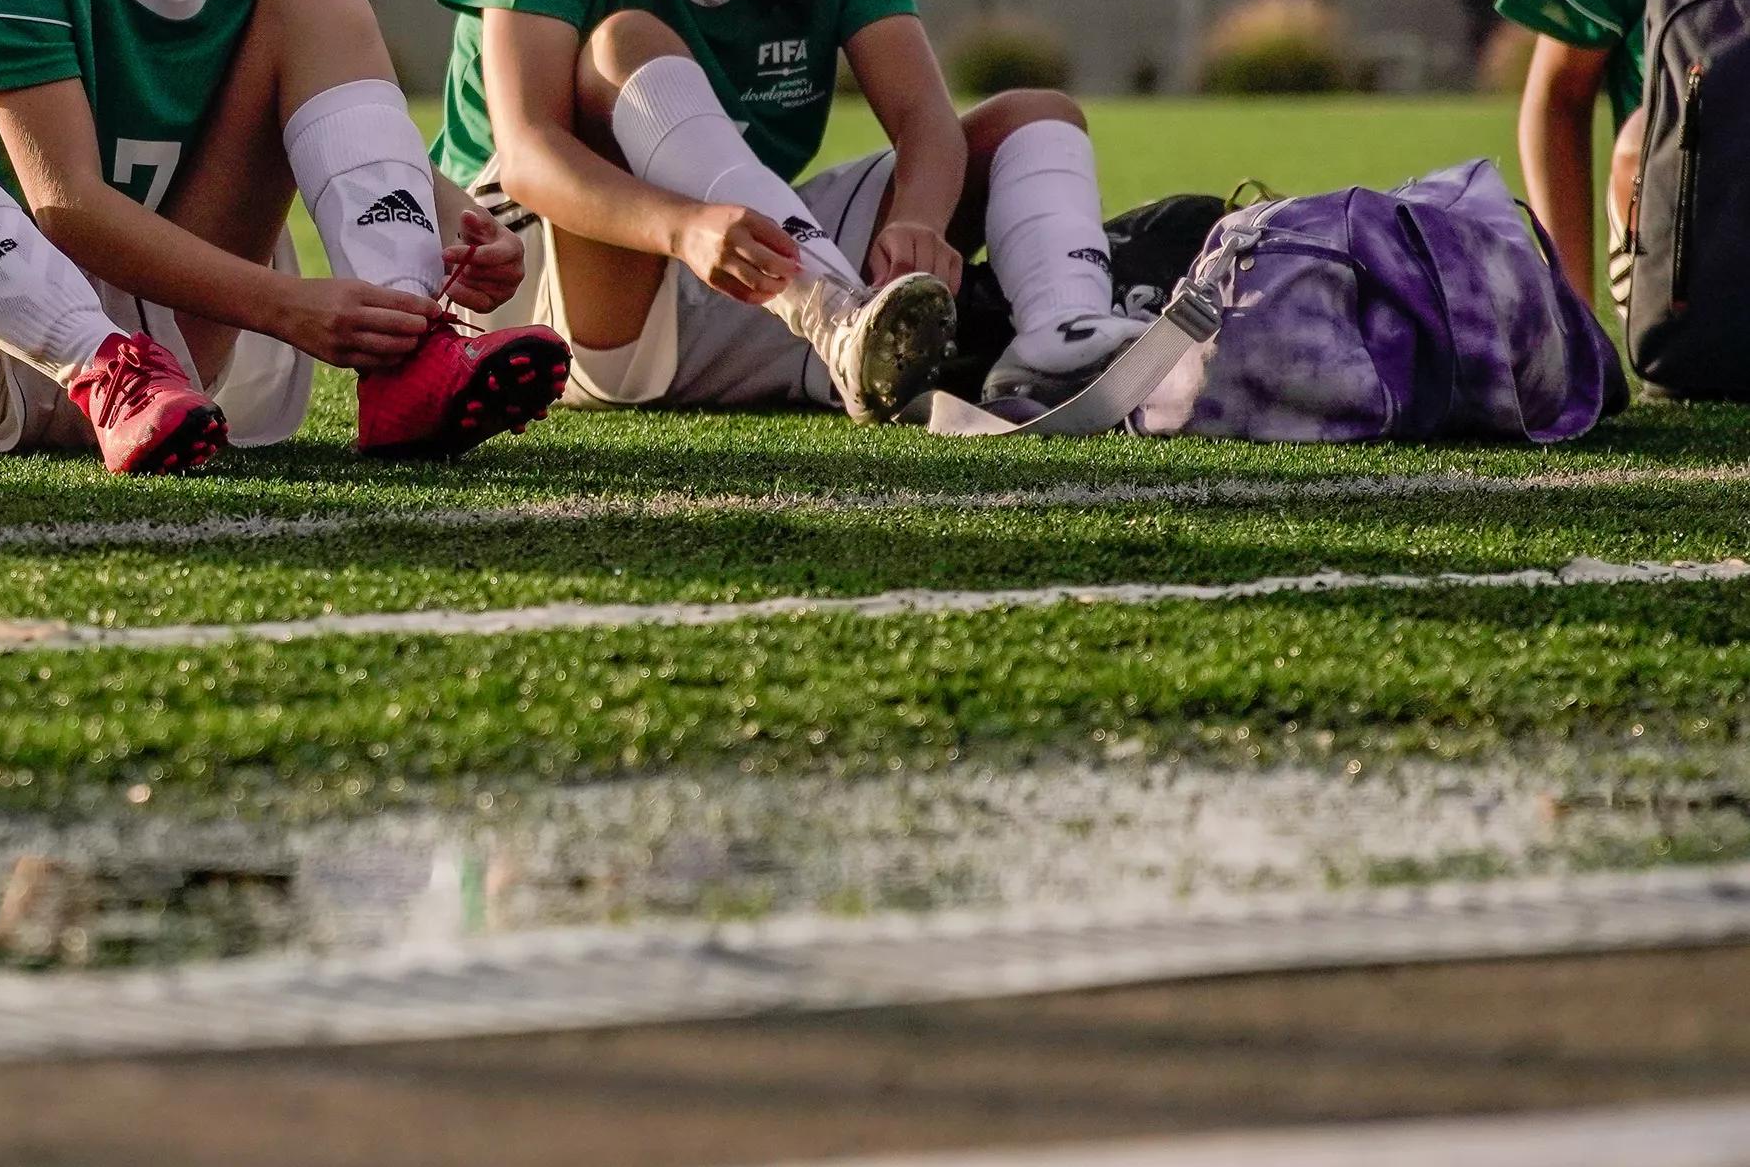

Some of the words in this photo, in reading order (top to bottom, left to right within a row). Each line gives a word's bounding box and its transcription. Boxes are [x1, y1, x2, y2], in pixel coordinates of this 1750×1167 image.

[758, 39, 808, 65] FIFA
[113, 138, 182, 213] 7
[357, 207, 435, 234] adidas
